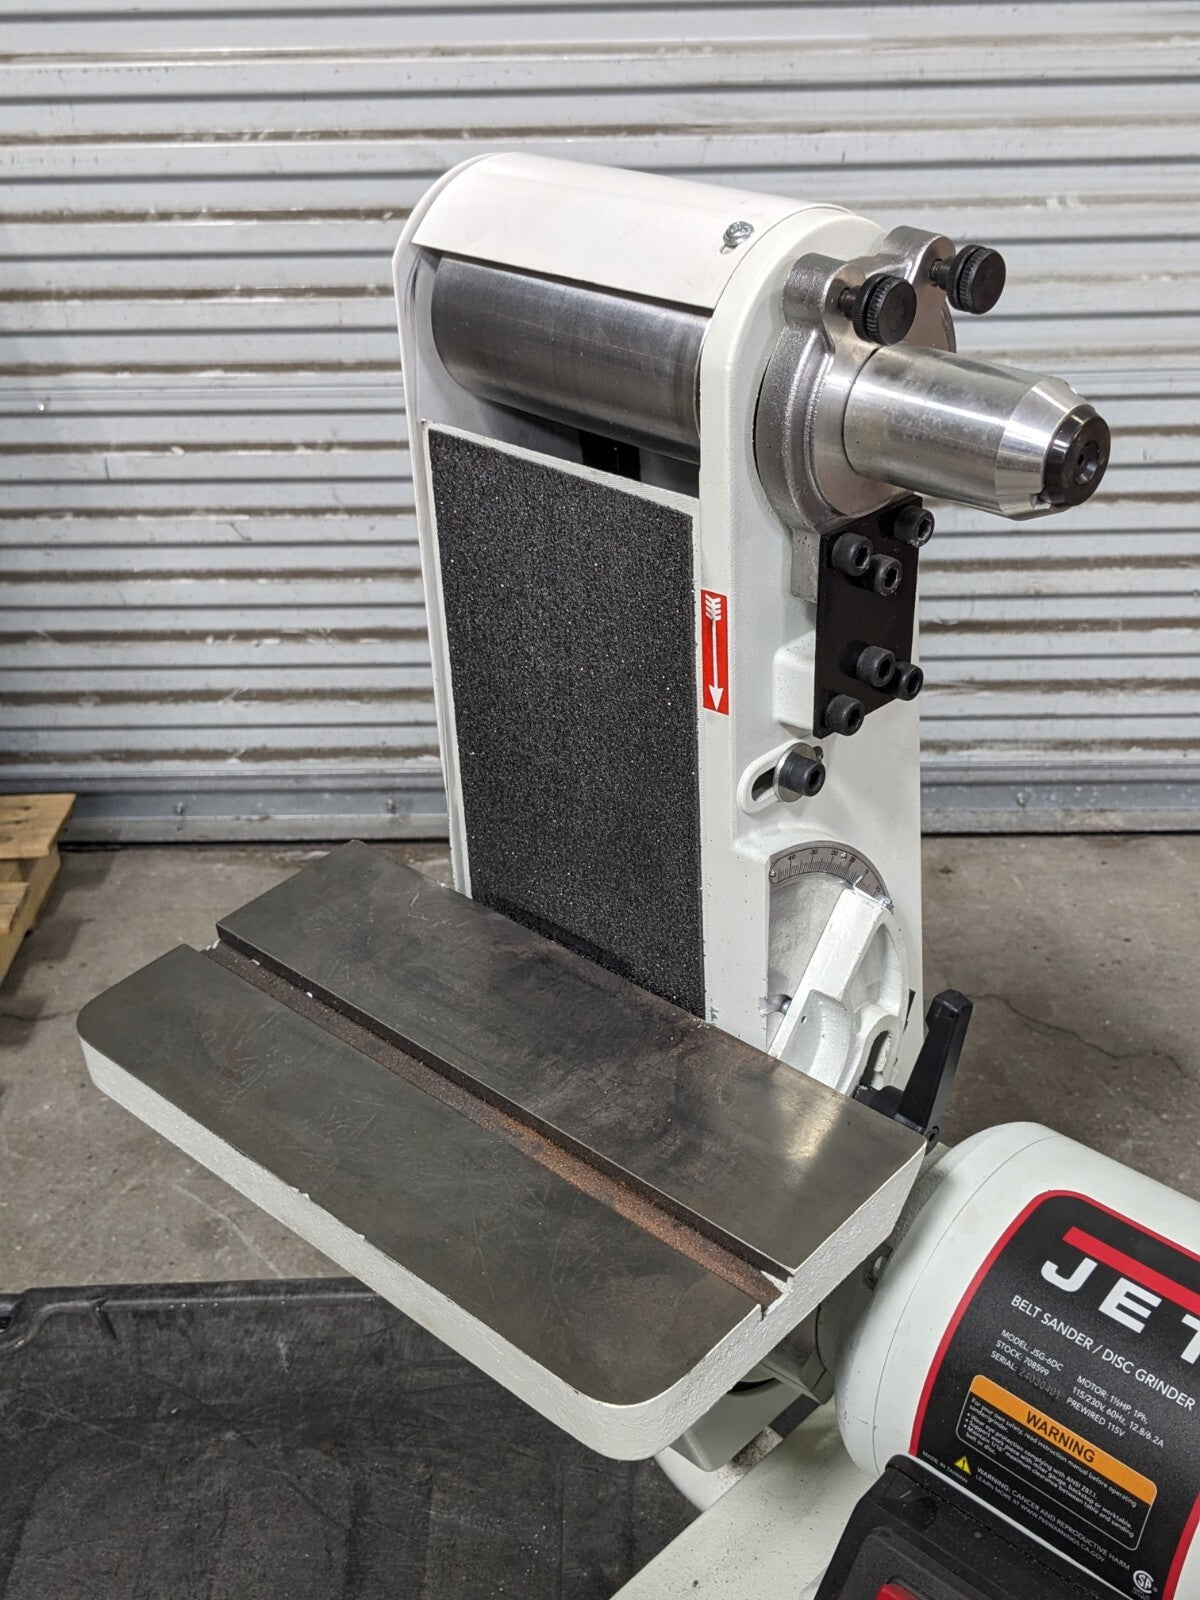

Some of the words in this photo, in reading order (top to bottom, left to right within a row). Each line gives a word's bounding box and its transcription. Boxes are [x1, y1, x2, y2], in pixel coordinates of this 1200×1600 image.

[989, 1350, 1019, 1371] SERIAL:
[994, 1339, 1023, 1360] STOCK:
[1022, 1356, 1050, 1377] 708599
[1000, 1329, 1031, 1351] MODEL:
[1029, 1347, 1064, 1372] JSG-6DC
[1010, 1294, 1042, 1319] BELT
[1039, 1311, 1094, 1350] SANDER
[1092, 1342, 1103, 1356] /
[1101, 1347, 1135, 1374] DISC
[1133, 1366, 1196, 1411] GRINDER
[1065, 1397, 1107, 1426] PREWIRED
[1105, 1421, 1126, 1437] 115V
[1076, 1375, 1109, 1399] MOTOR:
[1131, 1409, 1150, 1425] 1Ph,
[964, 1431, 977, 1442] belt
[969, 1414, 985, 1427] Wear
[983, 1424, 995, 1435] eye
[994, 1431, 1024, 1453] protection
[1022, 1449, 1053, 1472] complying
[1052, 1467, 1066, 1479] with
[1065, 1475, 1082, 1488] ANSI
[970, 1397, 982, 1407] For
[980, 1404, 993, 1416] your
[993, 1413, 1005, 1423] own
[1004, 1420, 1024, 1436] safety,
[1023, 1432, 1038, 1444] read
[1036, 1440, 1068, 1463] instruction
[1066, 1459, 1089, 1476] manual
[1087, 1472, 1109, 1489] before
[1107, 1485, 1138, 1508] operating
[1027, 1410, 1097, 1464] WARNING
[1104, 1407, 1129, 1426] 60Hz,
[1128, 1420, 1166, 1448] 12.8/6.2A
[966, 1426, 991, 1445] Maintain
[1003, 1450, 1032, 1471] maximum
[1030, 1467, 1059, 1488] clearance
[1057, 1485, 1084, 1505] between
[1082, 1501, 1100, 1515] table
[1099, 1512, 1111, 1522] and
[1109, 1519, 1135, 1538] sanding
[967, 1420, 991, 1438] Support
[989, 1434, 1005, 1447] work
[1003, 1443, 1021, 1458] piece
[1019, 1453, 1033, 1465] with
[1031, 1461, 1049, 1475] miter
[1066, 1484, 1094, 1504] backstop
[974, 1473, 995, 1490] LEARN
[993, 1486, 1012, 1501] MORE
[978, 1466, 1013, 1493] WARNING:
[1010, 1488, 1041, 1511] CANCER
[1039, 1507, 1057, 1522] AND
[1054, 1518, 1109, 1556] REPRODUCTIVE
[1107, 1552, 1131, 1571] HARM
